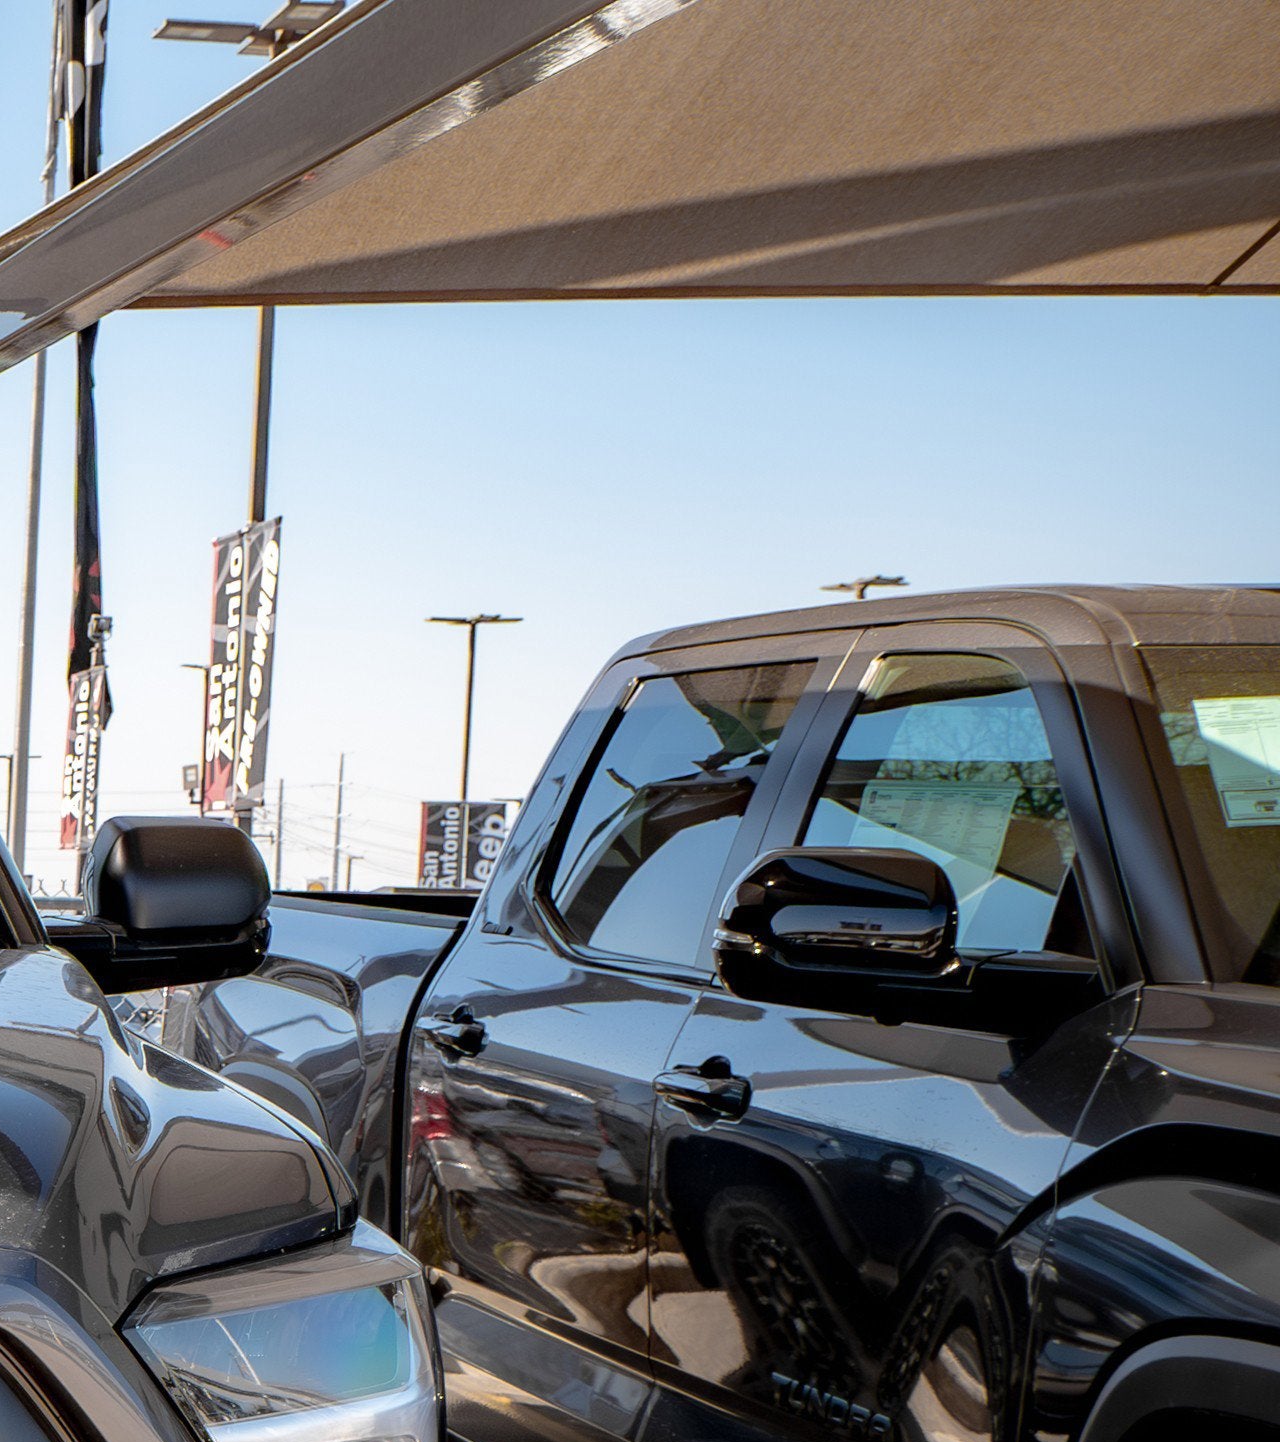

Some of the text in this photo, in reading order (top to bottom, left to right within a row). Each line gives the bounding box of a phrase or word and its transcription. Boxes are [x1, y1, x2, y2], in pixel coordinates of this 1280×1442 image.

[217, 546, 243, 761] Antonio
[236, 539, 279, 796] PRE-OWNED
[205, 663, 223, 762] San
[422, 850, 439, 888] San
[439, 806, 460, 888] Antonio
